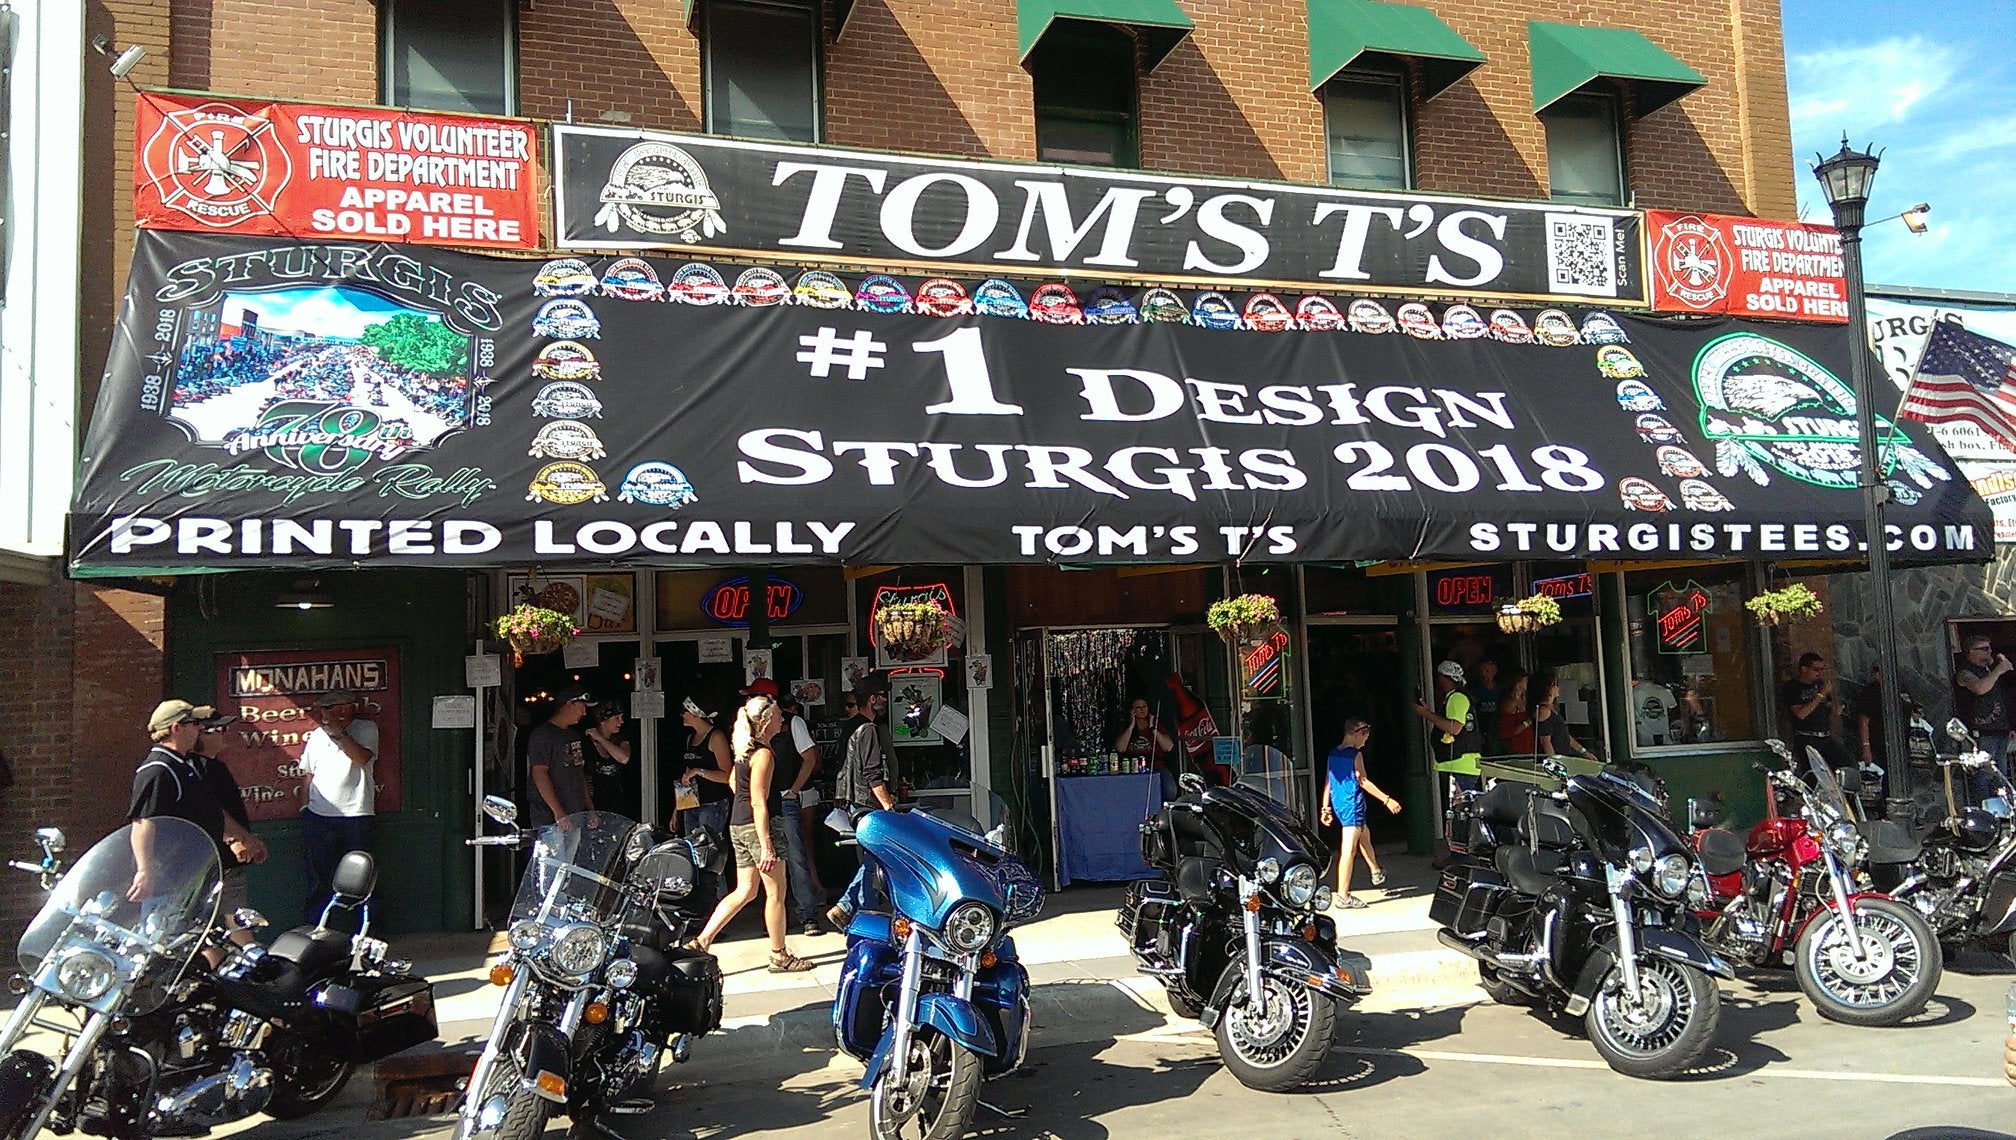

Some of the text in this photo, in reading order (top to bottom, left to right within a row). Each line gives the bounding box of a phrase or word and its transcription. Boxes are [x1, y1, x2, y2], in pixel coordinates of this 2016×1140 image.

[297, 114, 529, 162] STURGIS VOLUNTEER
[309, 147, 522, 191] FIRE DEPARTMENT
[186, 200, 252, 217] RESCUE
[339, 186, 494, 216] APPAREL
[650, 192, 705, 205] STURGIS
[312, 209, 521, 242] SOLD HERE
[771, 161, 1275, 276] TOM'S
[1314, 204, 1508, 287] T'S
[1677, 223, 1705, 234] FIRE
[1733, 225, 1844, 256] STURGIS VOLUNTE
[1616, 229, 1628, 287] Scan Me!
[1741, 249, 1845, 278] FIRE DEPARTMEN
[156, 245, 503, 333] STURGIS
[1681, 290, 1715, 301] RESCUE
[1746, 294, 1799, 313] SOLD
[1759, 277, 1841, 300] APPAREL
[140, 309, 177, 411] 1938 2018
[476, 338, 495, 427] 1938 2018
[1065, 367, 1516, 438] DESIGN
[223, 426, 407, 461] Anniversary
[737, 428, 1606, 502] STURGIS 2018
[119, 460, 491, 510] Motorcycle Rally
[110, 517, 856, 554] PRINTED LOCALLY
[1011, 525, 1298, 556] TOM'S T'S
[1469, 522, 1974, 552] STURGISTEES.COM
[714, 584, 793, 619] OPN
[1437, 576, 1493, 605] OPEN
[236, 663, 380, 693] MONAHANS
[240, 705, 311, 724] Beer
[239, 730, 313, 748] Wine
